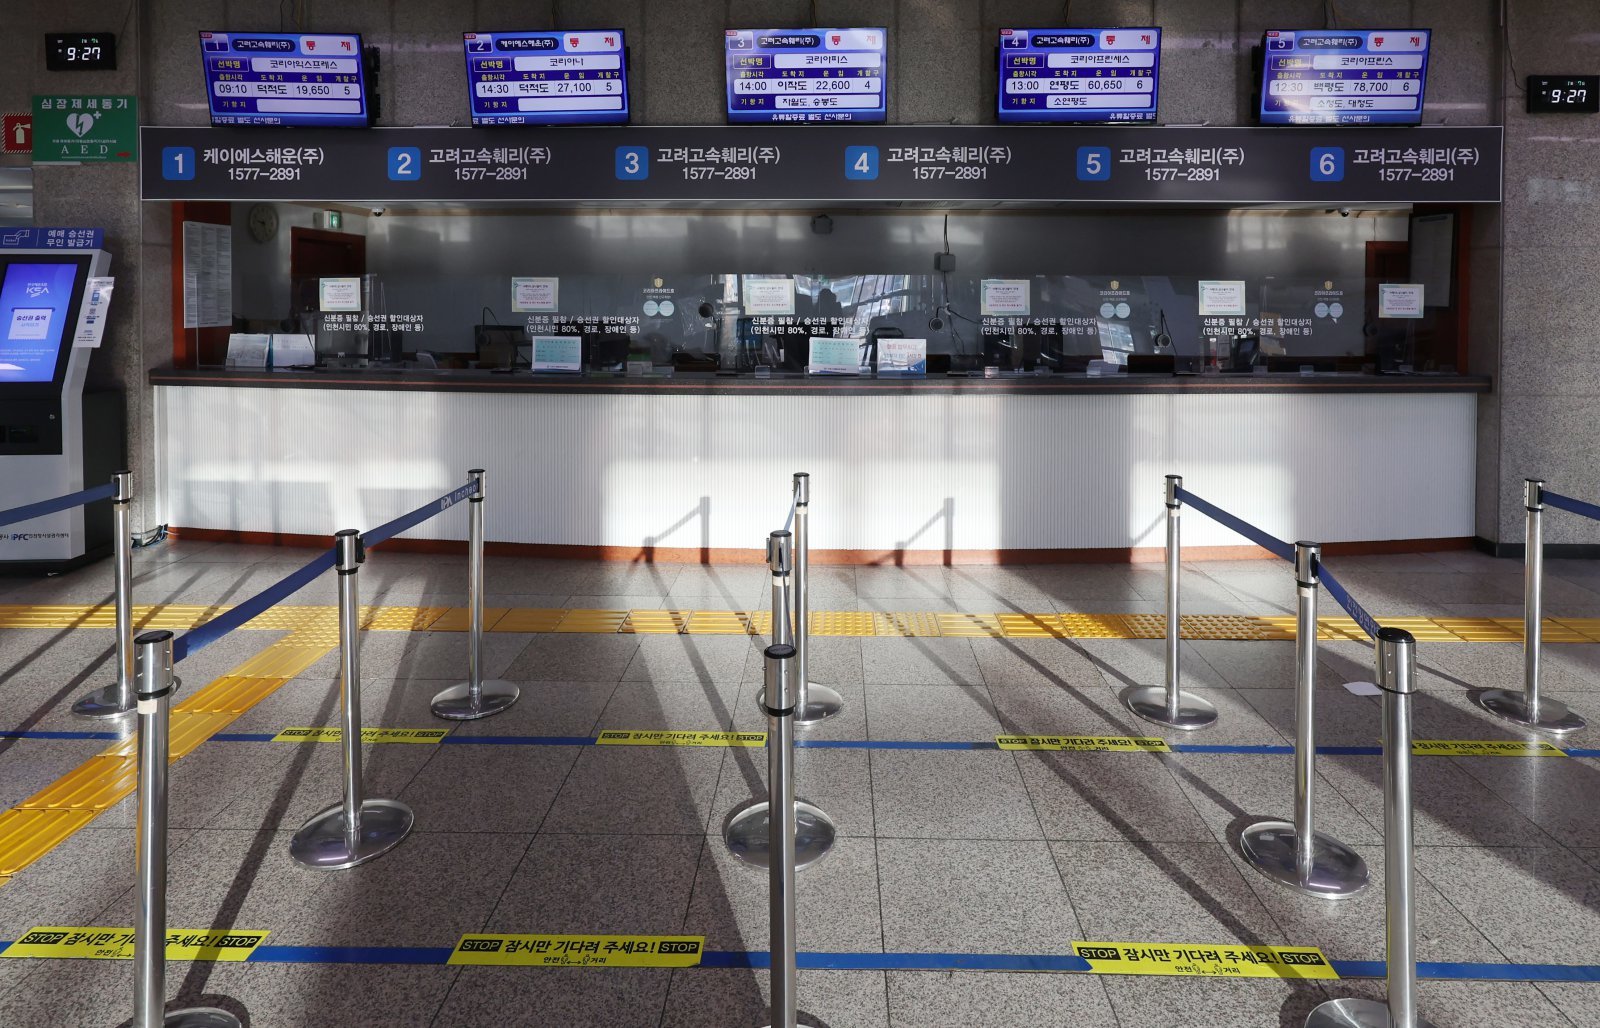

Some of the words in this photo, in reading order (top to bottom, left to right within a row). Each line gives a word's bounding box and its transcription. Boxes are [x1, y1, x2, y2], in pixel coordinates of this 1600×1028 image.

[214, 41, 219, 50] 1
[477, 40, 484, 51] 2
[737, 37, 745, 47] 3
[1011, 38, 1019, 47] 4
[1278, 37, 1286, 48] 5
[67, 47, 101, 61] 9:27
[1013, 57, 1037, 65] 선박명
[219, 84, 247, 94] 09:10
[257, 84, 287, 95] 덕적도
[296, 86, 330, 96] 19,650
[344, 86, 350, 94] 5
[481, 84, 509, 94] 14:30
[519, 83, 549, 93] 덕적도
[557, 83, 592, 93] 27,100
[606, 83, 612, 91] 5
[739, 82, 767, 91] 14:00
[778, 81, 807, 91] 이작도
[816, 81, 850, 91] 22,600
[864, 81, 870, 89] 4
[1011, 81, 1039, 90] 13:00
[1049, 80, 1080, 90] 연평도
[1088, 80, 1123, 90] 60,650
[1137, 80, 1143, 89] 6
[1353, 82, 1389, 92] 78,700
[1403, 83, 1410, 91] 6
[1551, 89, 1586, 103] 9:27
[1054, 98, 1087, 106] 소연평도
[204, 148, 323, 165] 케이에스해운(주)
[430, 147, 550, 164] 고려고속훼리(주)
[658, 147, 780, 165] 고려고속훼리(주)
[888, 147, 1011, 165] 고려고속훼리(주)
[1120, 148, 1244, 165] 고려고속훼리(주)
[1354, 148, 1478, 165] 고려고속훼리(주)
[175, 154, 182, 173] 1
[398, 154, 411, 174] 2
[625, 153, 639, 173] 3
[855, 153, 869, 172] 4
[1087, 154, 1100, 174] 5
[1320, 154, 1334, 174] 6
[229, 168, 299, 180] 1577-2891
[455, 168, 526, 180] 1577-2891
[683, 167, 755, 179] 1577-2891
[913, 167, 986, 179] 1577-2891
[1145, 168, 1219, 181] 1577-2891
[1380, 169, 1453, 181] 1577-2891
[48, 230, 65, 238] 예매
[68, 230, 94, 238] 승선권
[46, 239, 64, 247] 무인
[68, 239, 93, 247] 발급기
[553, 316, 567, 324] 필참
[577, 316, 599, 324] 승선권
[602, 316, 639, 324] 할인대상자
[751, 317, 774, 325] 신분증
[778, 317, 793, 325] 필참
[804, 317, 827, 325] 승선권
[1204, 318, 1225, 326] 신분증
[1229, 318, 1243, 326] 필참
[1277, 319, 1312, 327] 할인대상자
[414, 324, 424, 332] 등)
[527, 325, 559, 333] (인천시민
[604, 326, 627, 334] 장애인
[630, 326, 640, 334] 등)
[751, 327, 785, 335] (인천시민
[787, 327, 807, 335] 80%,
[981, 327, 1015, 335] (인천시민
[1087, 327, 1097, 336] 등)
[1203, 327, 1235, 336] (인천시민
[1238, 328, 1256, 336] 80%,
[1279, 328, 1300, 336] 장애인
[1303, 327, 1313, 336] 등)
[379, 730, 413, 738] 주세요!
[21, 933, 65, 943] STOP
[65, 932, 117, 946] 잠시만
[166, 934, 218, 947] 주세요!
[217, 937, 258, 946] STOP
[462, 941, 500, 950] STOP
[505, 940, 552, 953] 잠시만
[555, 940, 600, 954] 기다려
[603, 941, 656, 954] 주세요!
[660, 942, 698, 952] STOP
[543, 956, 560, 964] 안전
[1079, 949, 1117, 959] STOP
[1123, 948, 1170, 963] 잠시만
[1174, 950, 1221, 964] 기다려
[1225, 951, 1279, 965] 주세요!
[1282, 953, 1320, 964] STOP
[1175, 965, 1192, 973] 안전
